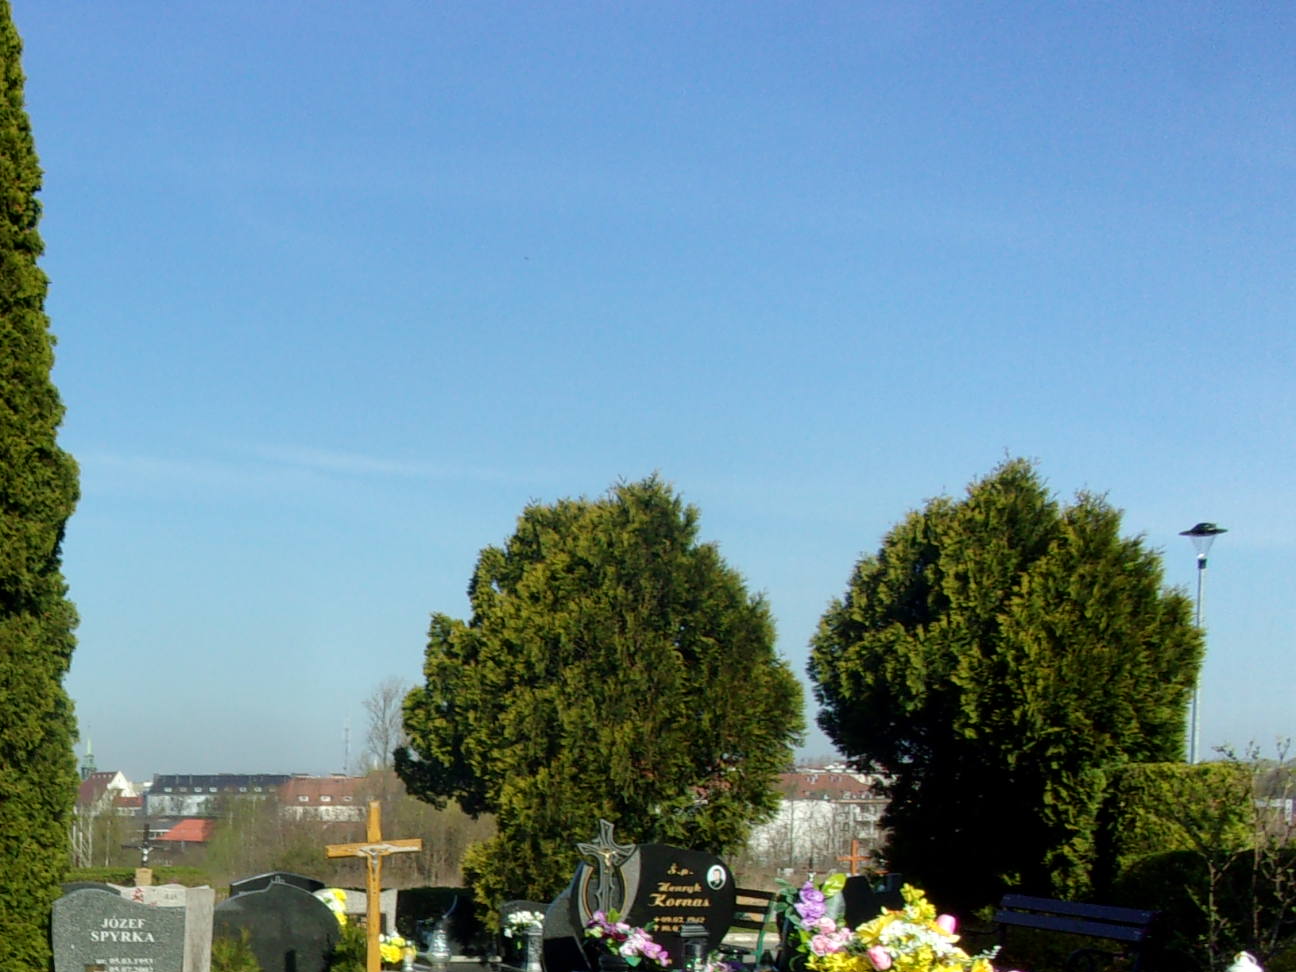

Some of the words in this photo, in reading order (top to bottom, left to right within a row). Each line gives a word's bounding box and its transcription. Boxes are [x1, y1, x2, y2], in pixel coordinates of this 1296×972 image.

[657, 882, 703, 893] Henryk
[648, 893, 712, 907] Kornas
[101, 916, 146, 928] JÓZEF
[90, 931, 155, 943] SPYRKA
